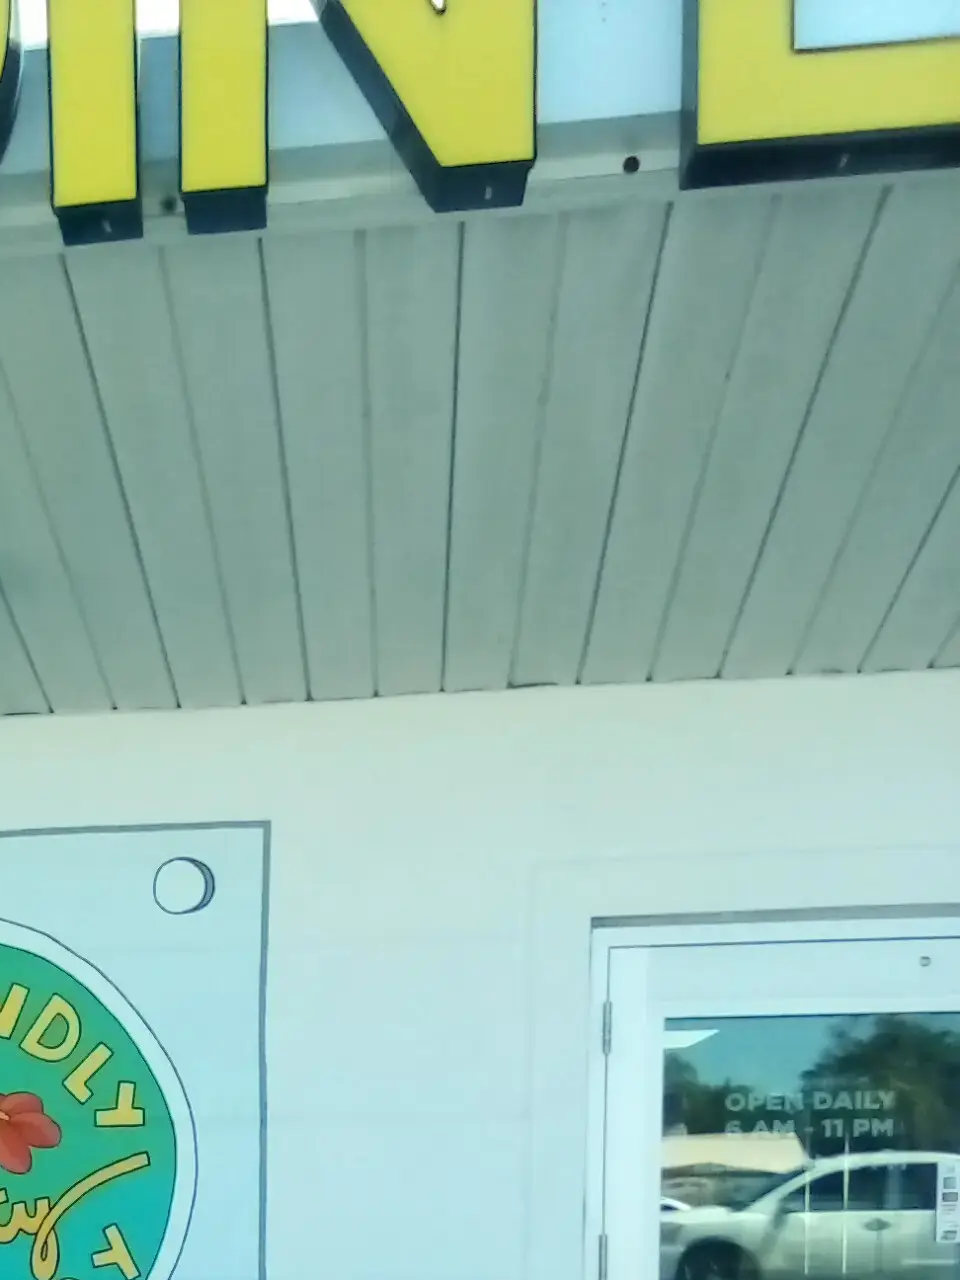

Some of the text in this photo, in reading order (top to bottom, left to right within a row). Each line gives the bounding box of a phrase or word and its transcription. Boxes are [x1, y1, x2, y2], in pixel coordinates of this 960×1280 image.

[725, 1090, 896, 1112] OPEN DAILY
[752, 1119, 796, 1137] AM
[821, 1119, 843, 1137] 11
[853, 1119, 894, 1137] PM
